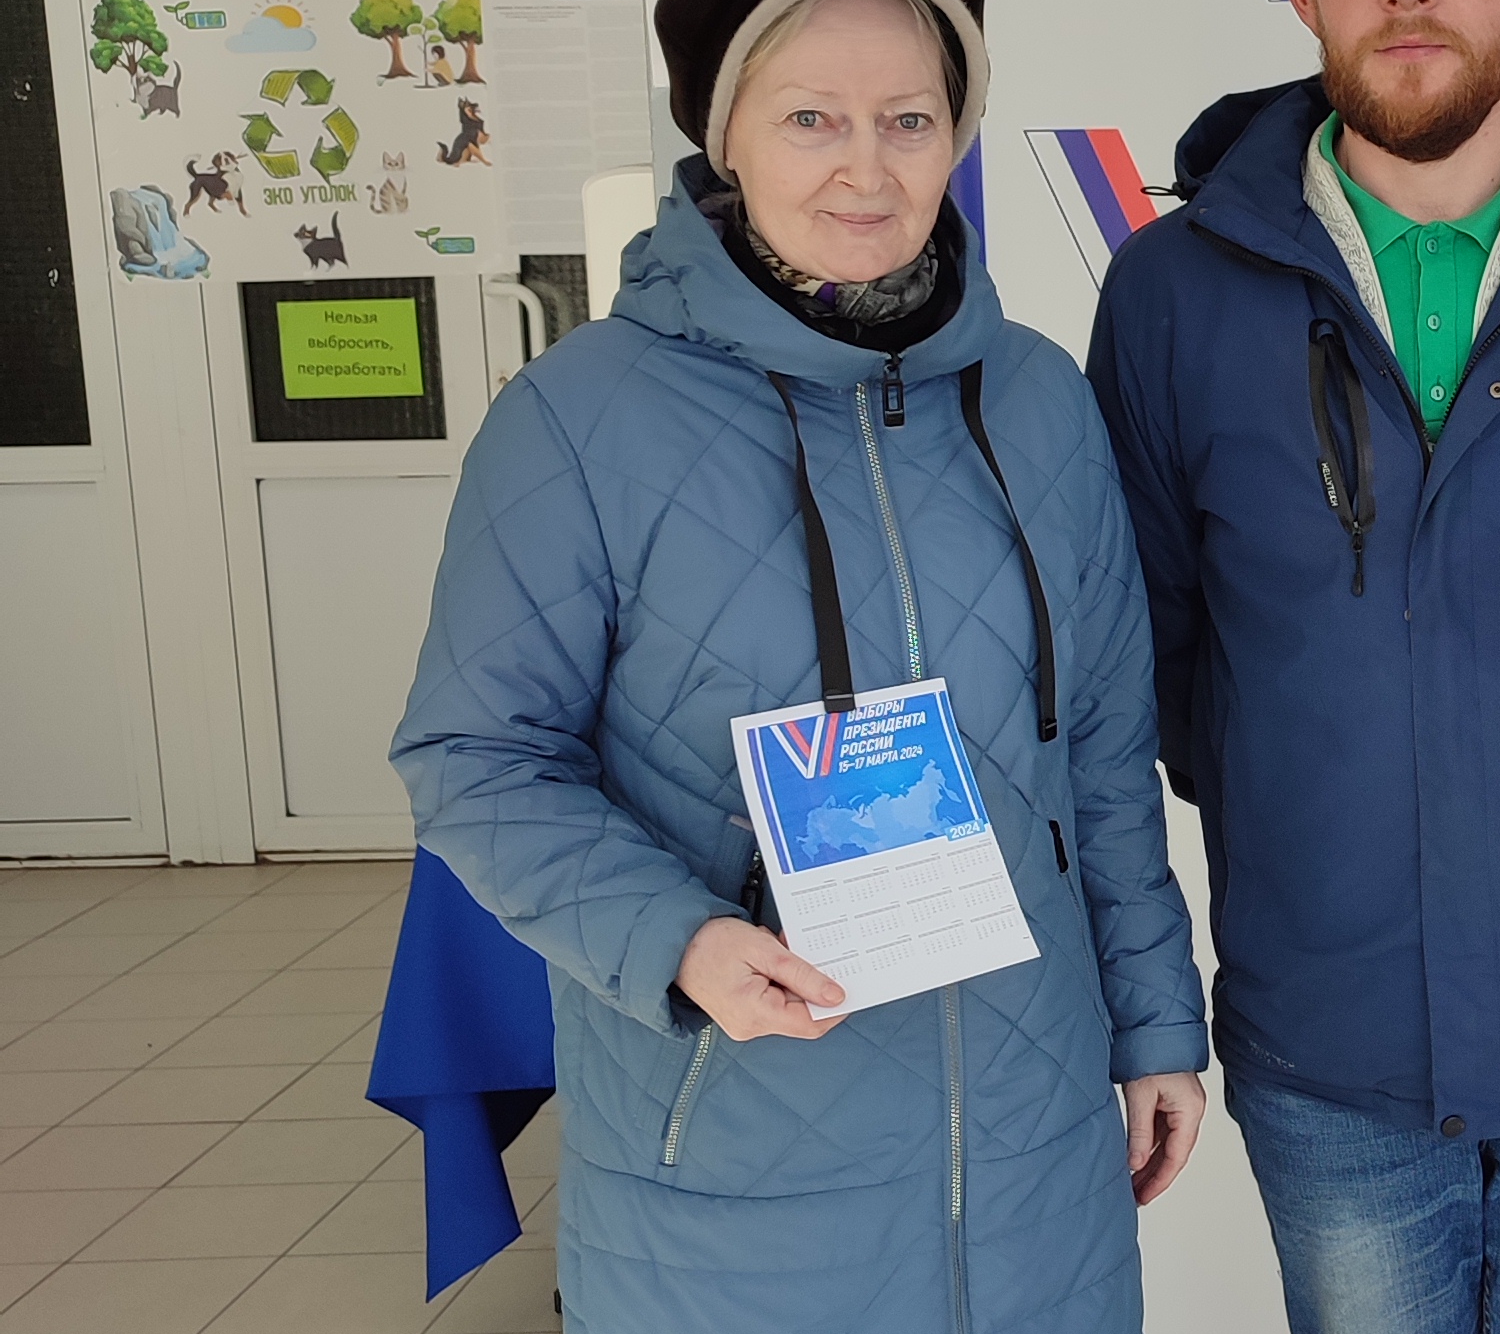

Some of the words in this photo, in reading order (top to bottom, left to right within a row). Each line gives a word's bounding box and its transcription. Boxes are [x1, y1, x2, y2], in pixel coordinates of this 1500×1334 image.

[263, 186, 294, 205] ЭКО
[300, 184, 358, 204] УГОЛОК
[324, 310, 378, 324] Нельзя
[307, 335, 394, 351] выбросить,
[297, 362, 407, 377] переработать!
[843, 711, 926, 741] ПРЕЗИДЕНТА
[840, 734, 894, 758] РОССИИ
[866, 750, 899, 767] МАРТА
[900, 745, 923, 760] 2024
[950, 821, 981, 838] 2024
